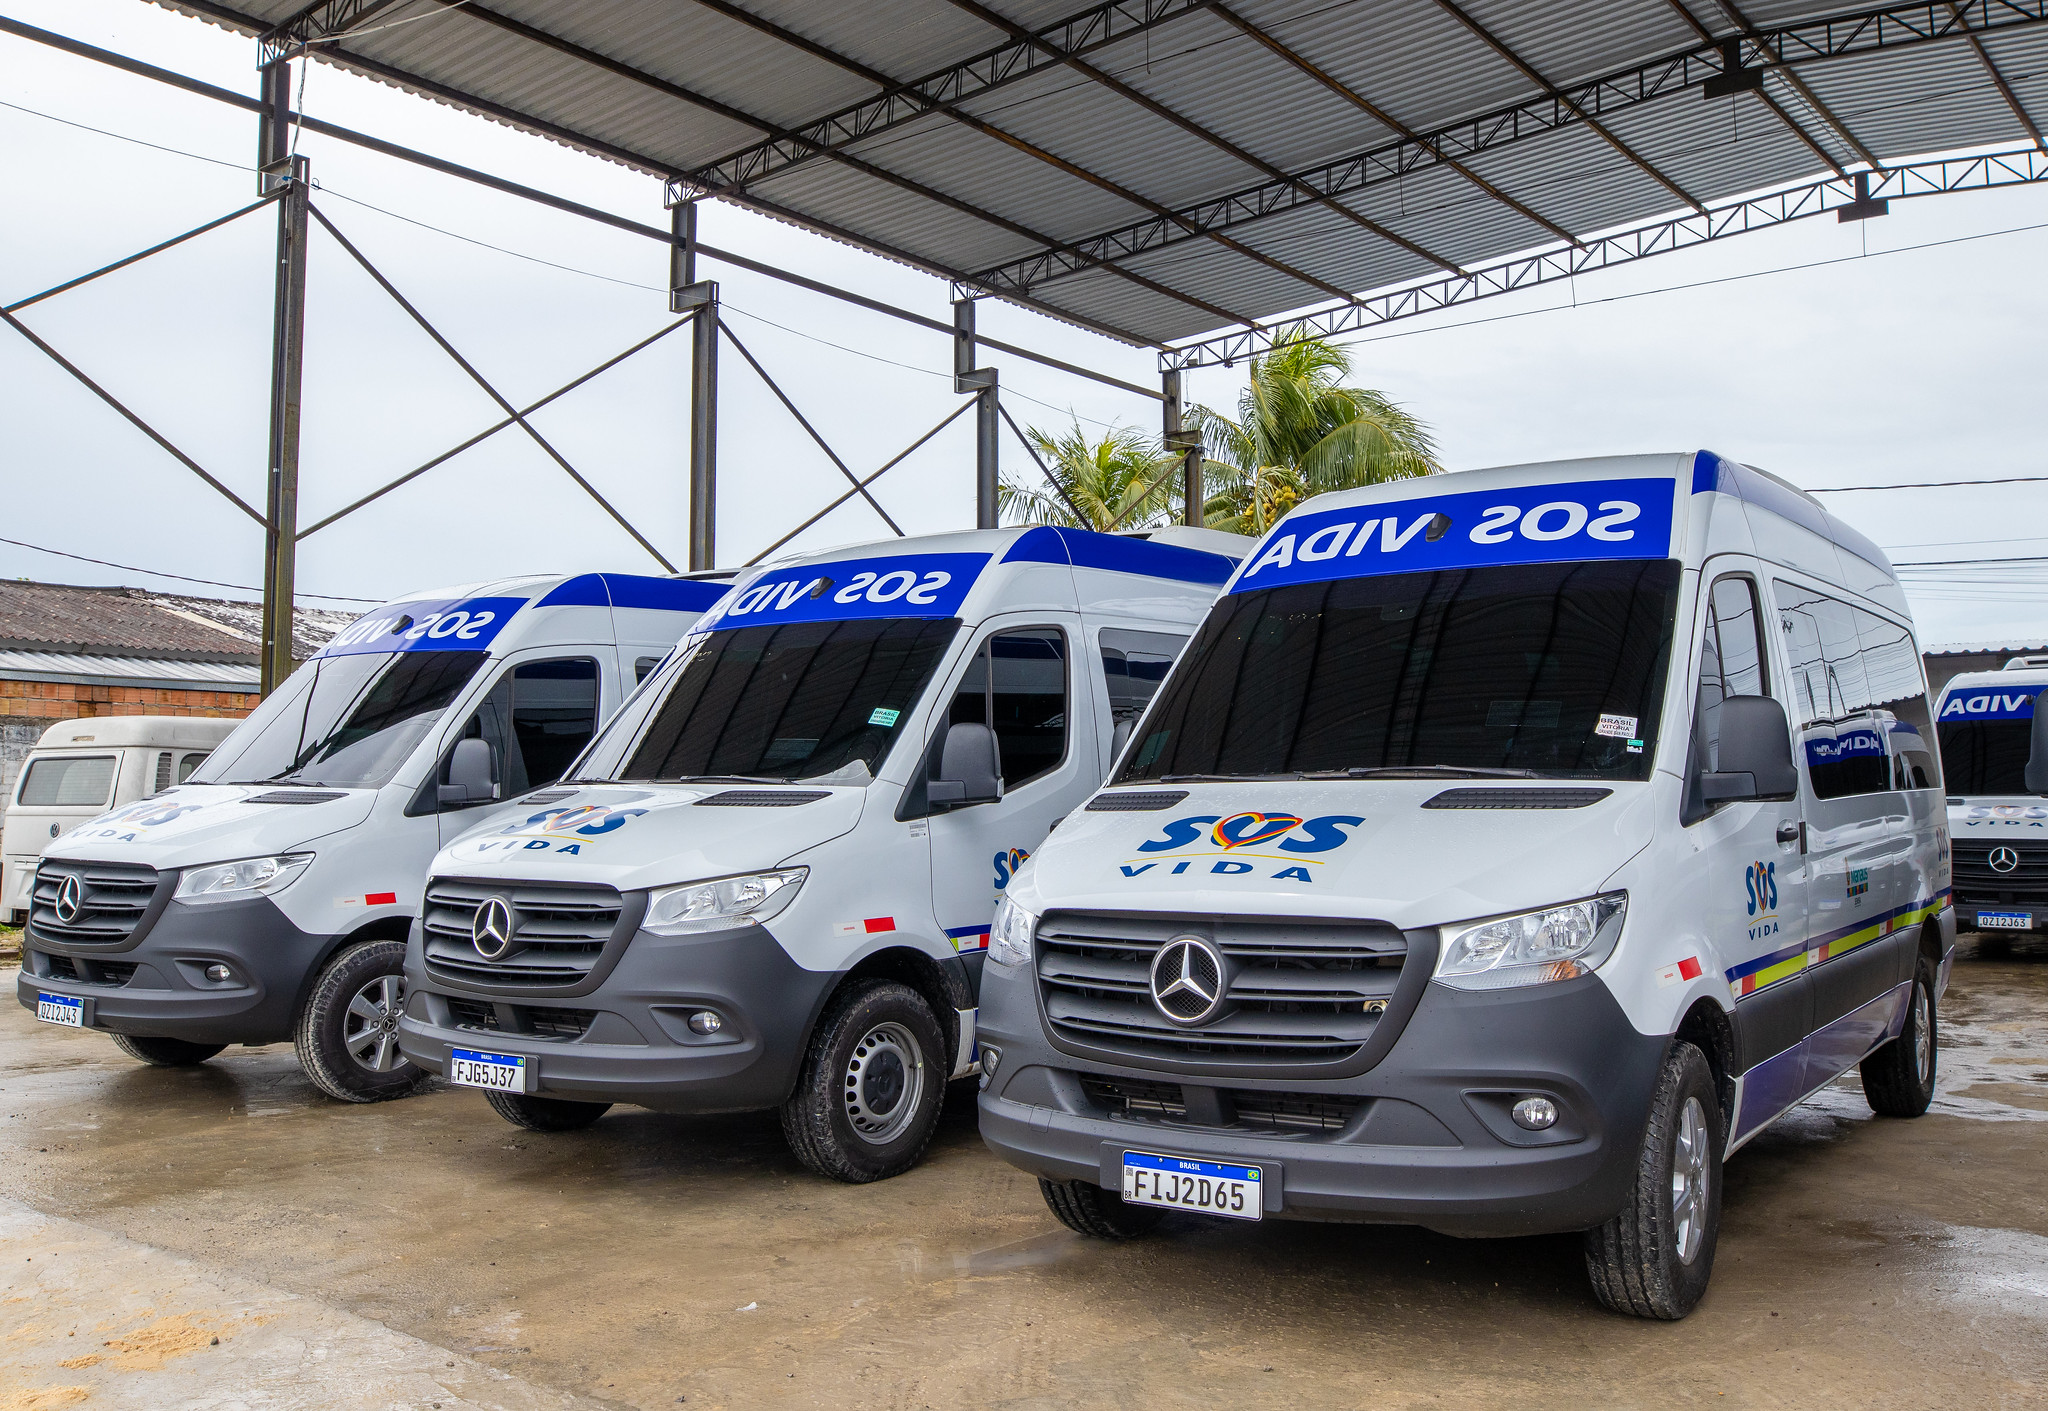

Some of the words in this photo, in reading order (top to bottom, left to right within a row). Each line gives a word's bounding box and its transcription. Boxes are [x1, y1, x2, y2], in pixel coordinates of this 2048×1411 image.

[1600, 718, 1633, 726] BRASIL
[95, 802, 203, 826] SOS
[500, 805, 650, 835] SOS
[1968, 805, 2048, 819] SOS
[71, 828, 138, 843] VIDA
[1136, 812, 1366, 853] SOS
[478, 840, 581, 855] VIDA
[1119, 861, 1312, 883] VIDA
[1746, 861, 1777, 916] SOS
[1748, 922, 1779, 941] VIDA
[1982, 916, 2026, 928] QZI2J63
[41, 1003, 77, 1024] QZI2J43
[457, 1061, 516, 1088] FJG5J37
[1179, 1161, 1202, 1171] BRASIL
[1124, 1190, 1132, 1199] BR
[1134, 1170, 1244, 1212] FIJ2D65
